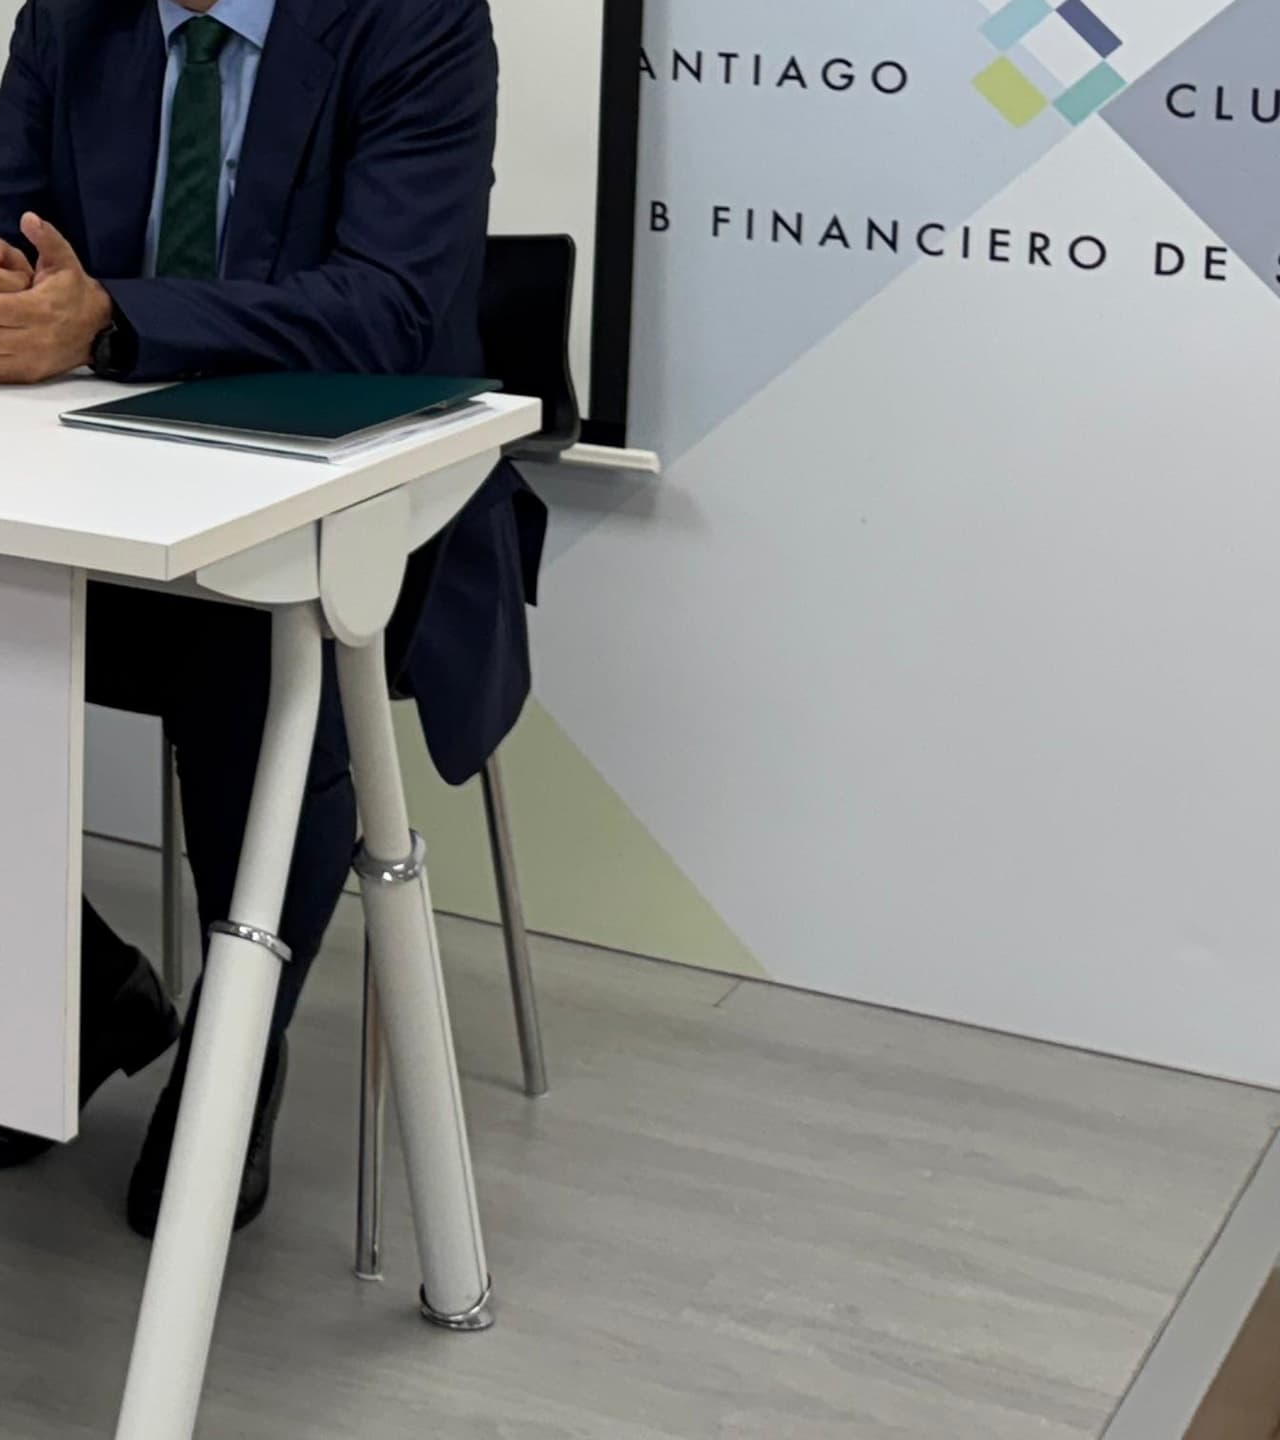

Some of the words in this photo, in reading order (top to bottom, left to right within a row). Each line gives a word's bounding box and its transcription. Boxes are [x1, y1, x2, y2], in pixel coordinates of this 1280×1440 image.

[640, 47, 908, 95] ANTIAGO
[1165, 83, 1280, 124] CLU
[711, 205, 1107, 270] FINANCIERO
[1154, 241, 1228, 281] DE
